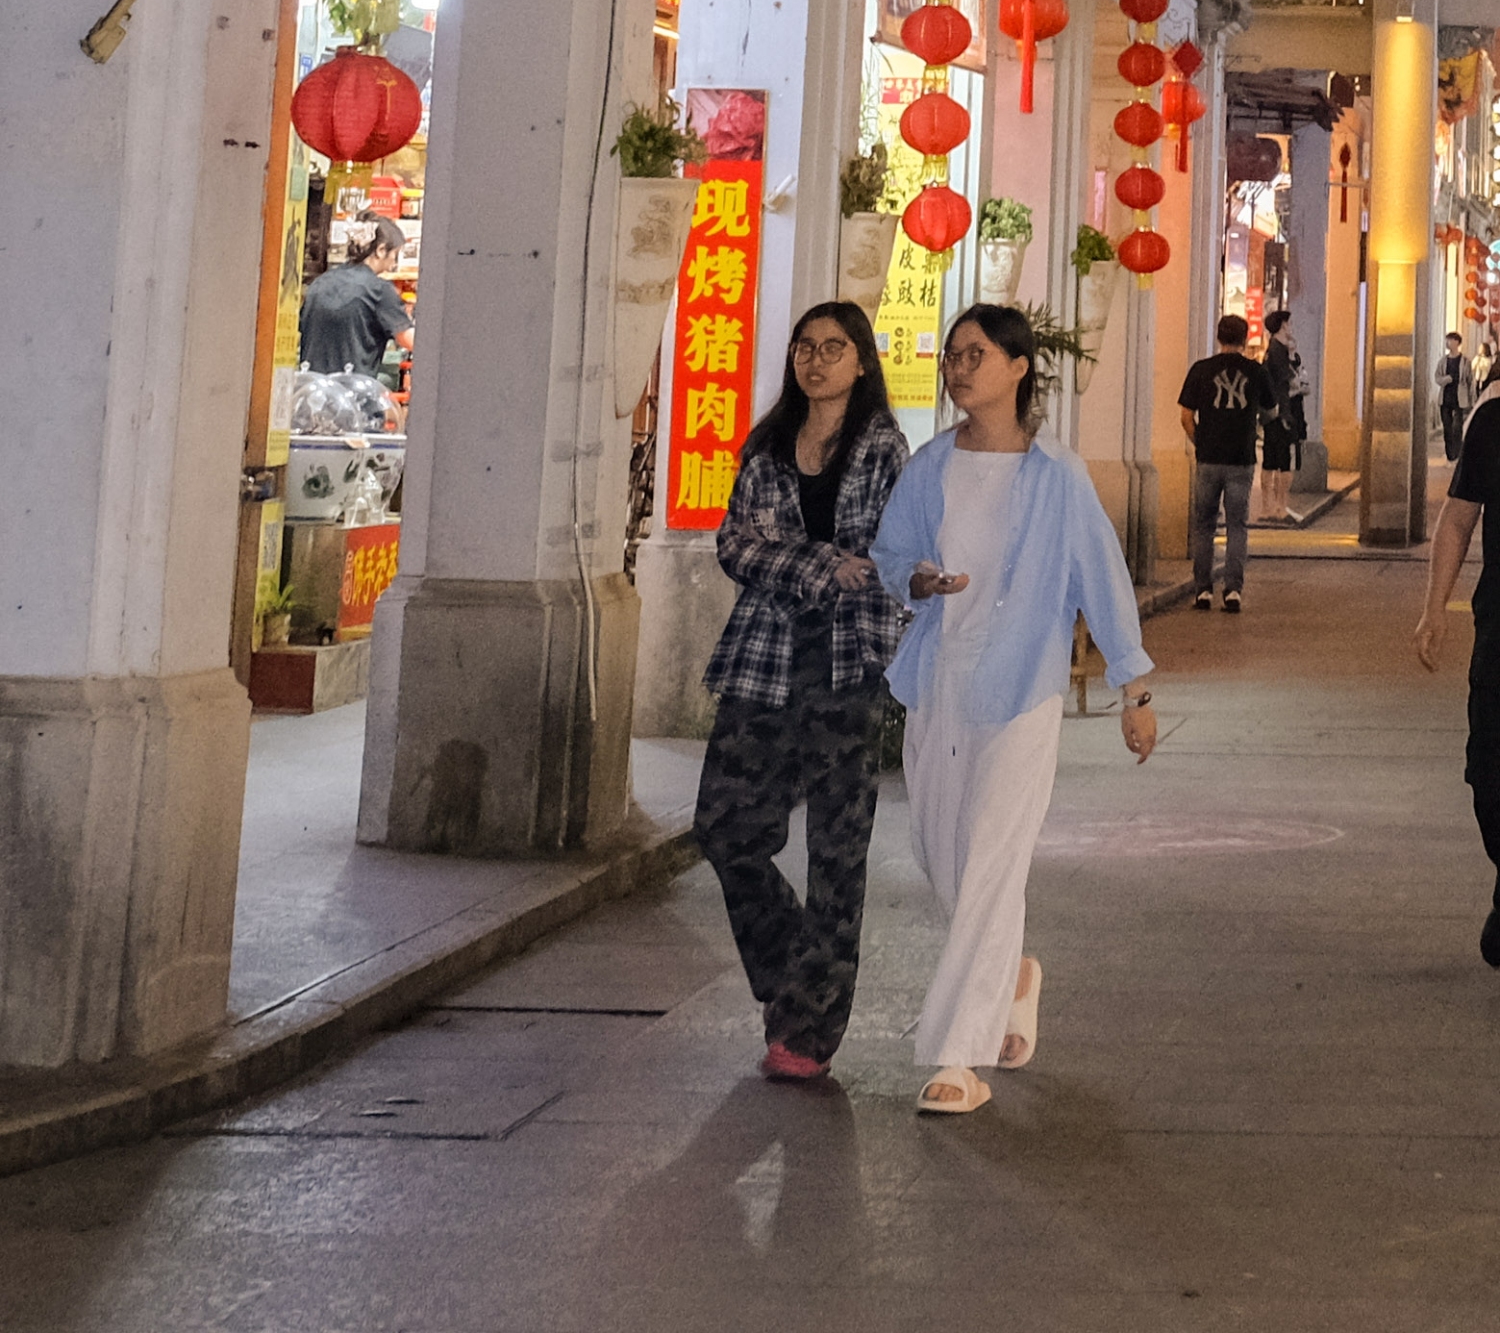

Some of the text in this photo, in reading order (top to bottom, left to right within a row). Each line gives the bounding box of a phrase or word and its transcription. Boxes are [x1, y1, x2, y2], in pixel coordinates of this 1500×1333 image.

[676, 179, 751, 511] 现烤猪肉脯
